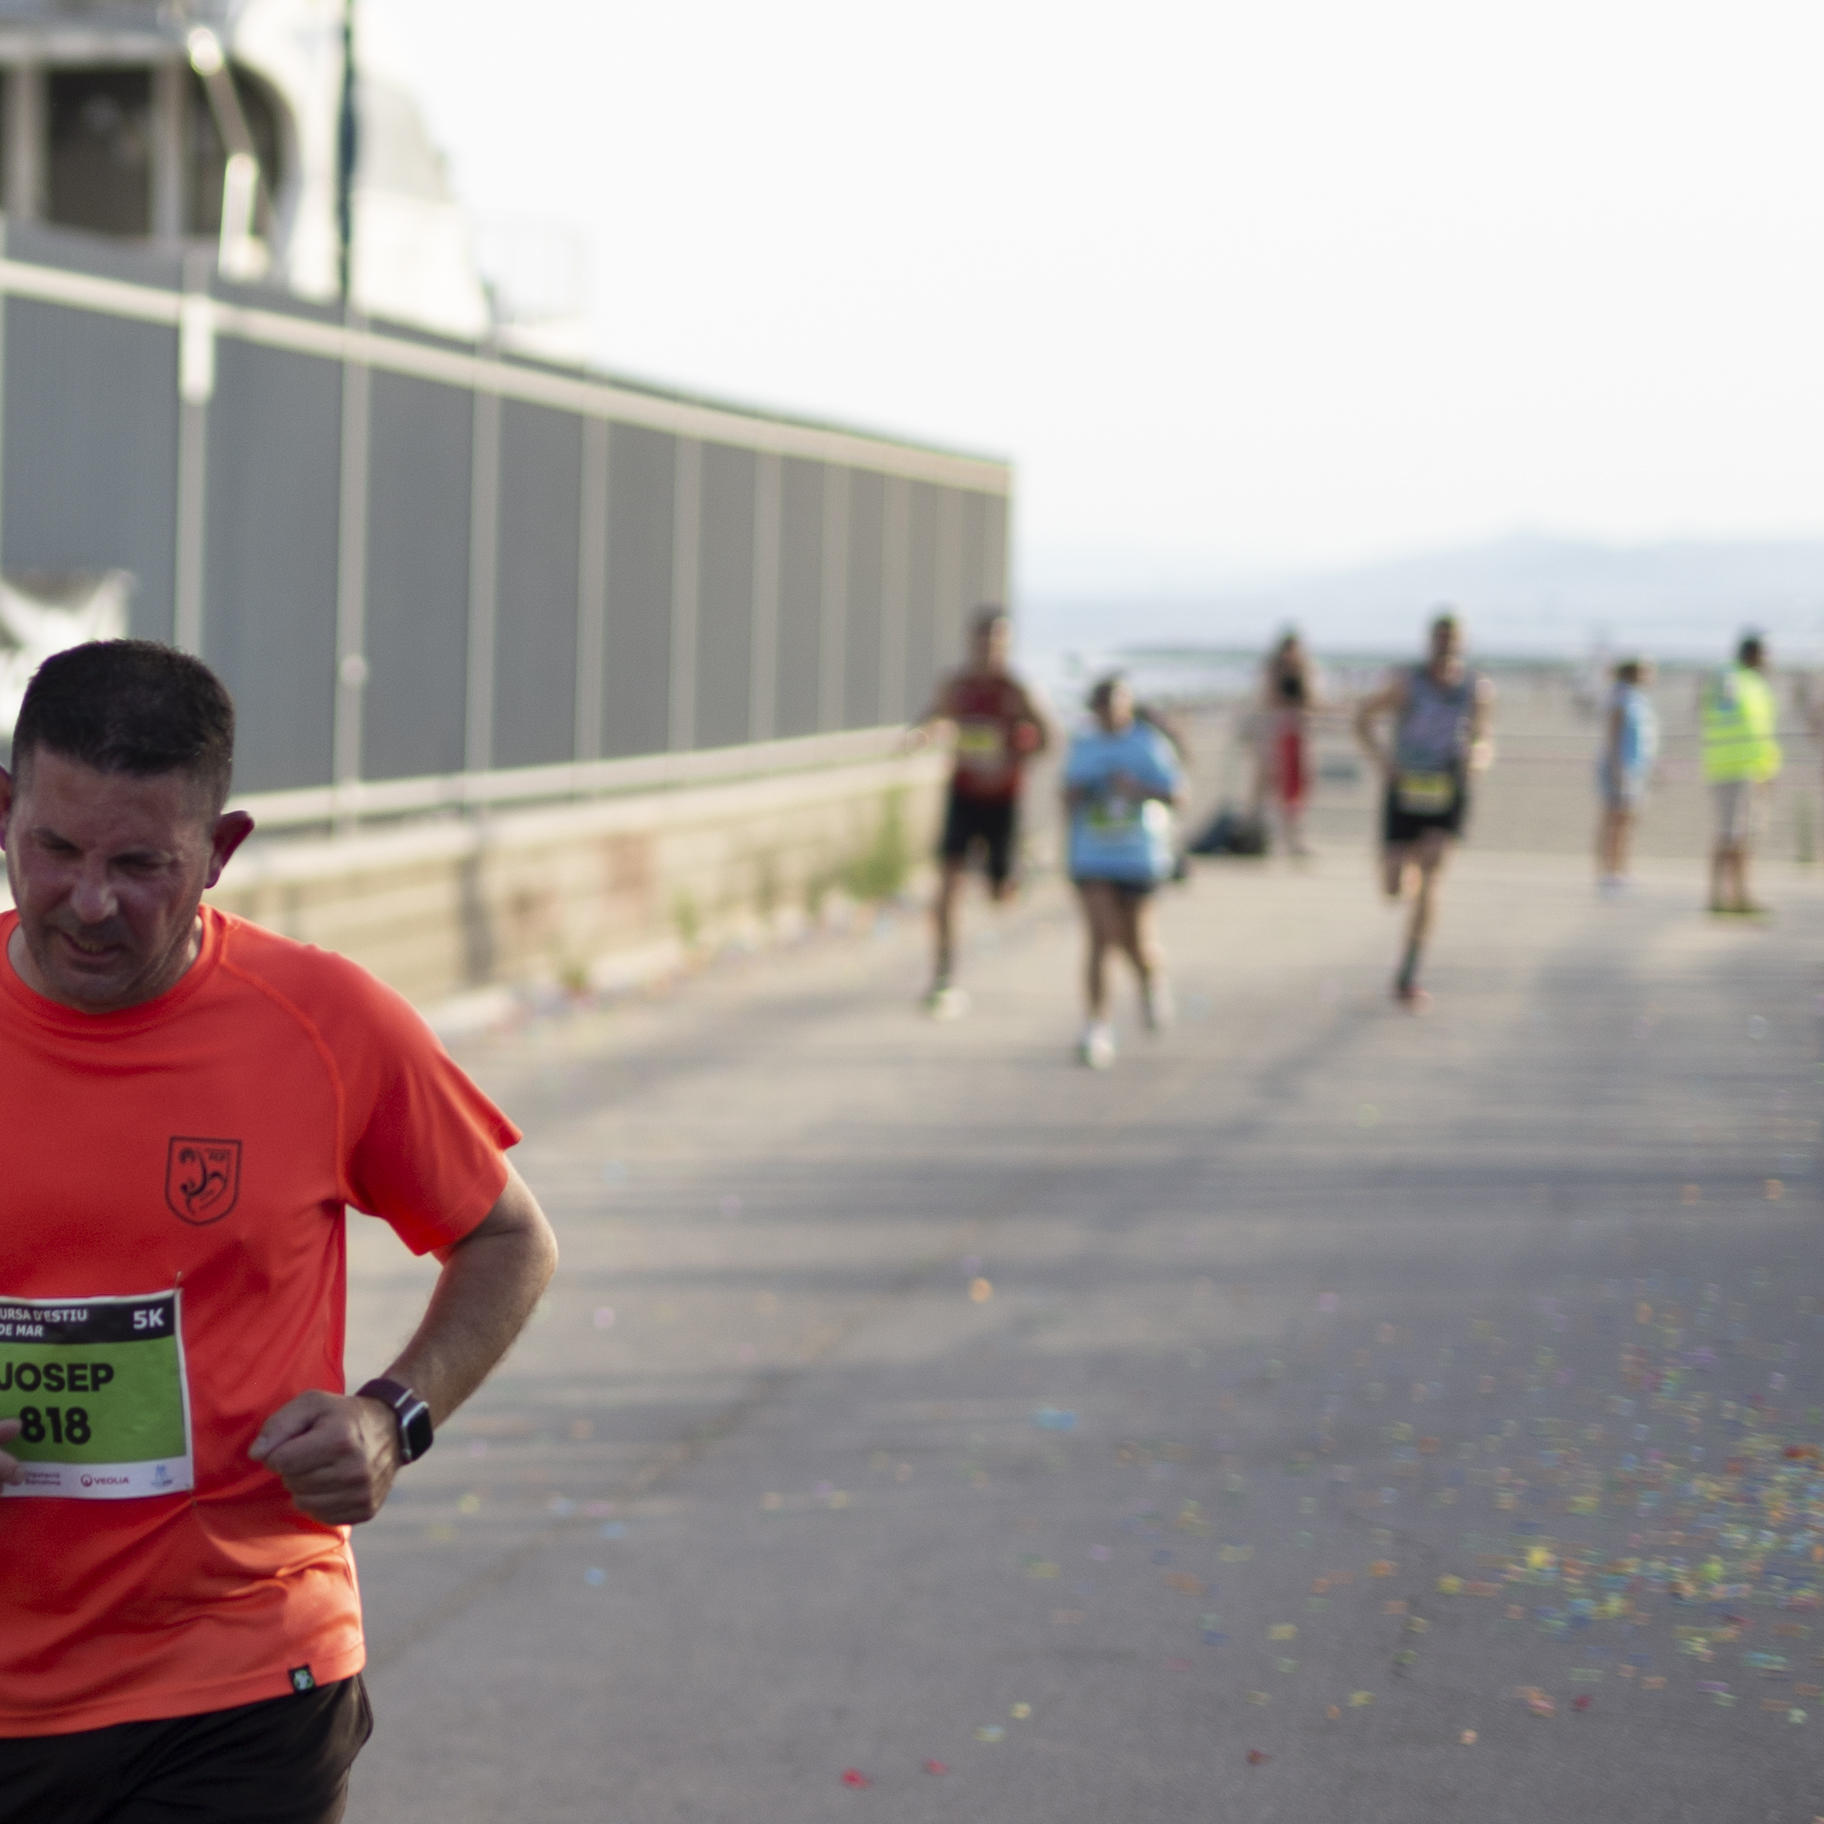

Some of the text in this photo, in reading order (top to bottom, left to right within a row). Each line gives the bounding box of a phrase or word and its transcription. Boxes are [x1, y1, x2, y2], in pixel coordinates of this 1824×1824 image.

[15, 1324, 45, 1337] MAR
[132, 1307, 165, 1331] 5K
[19, 1405, 92, 1446] 818
